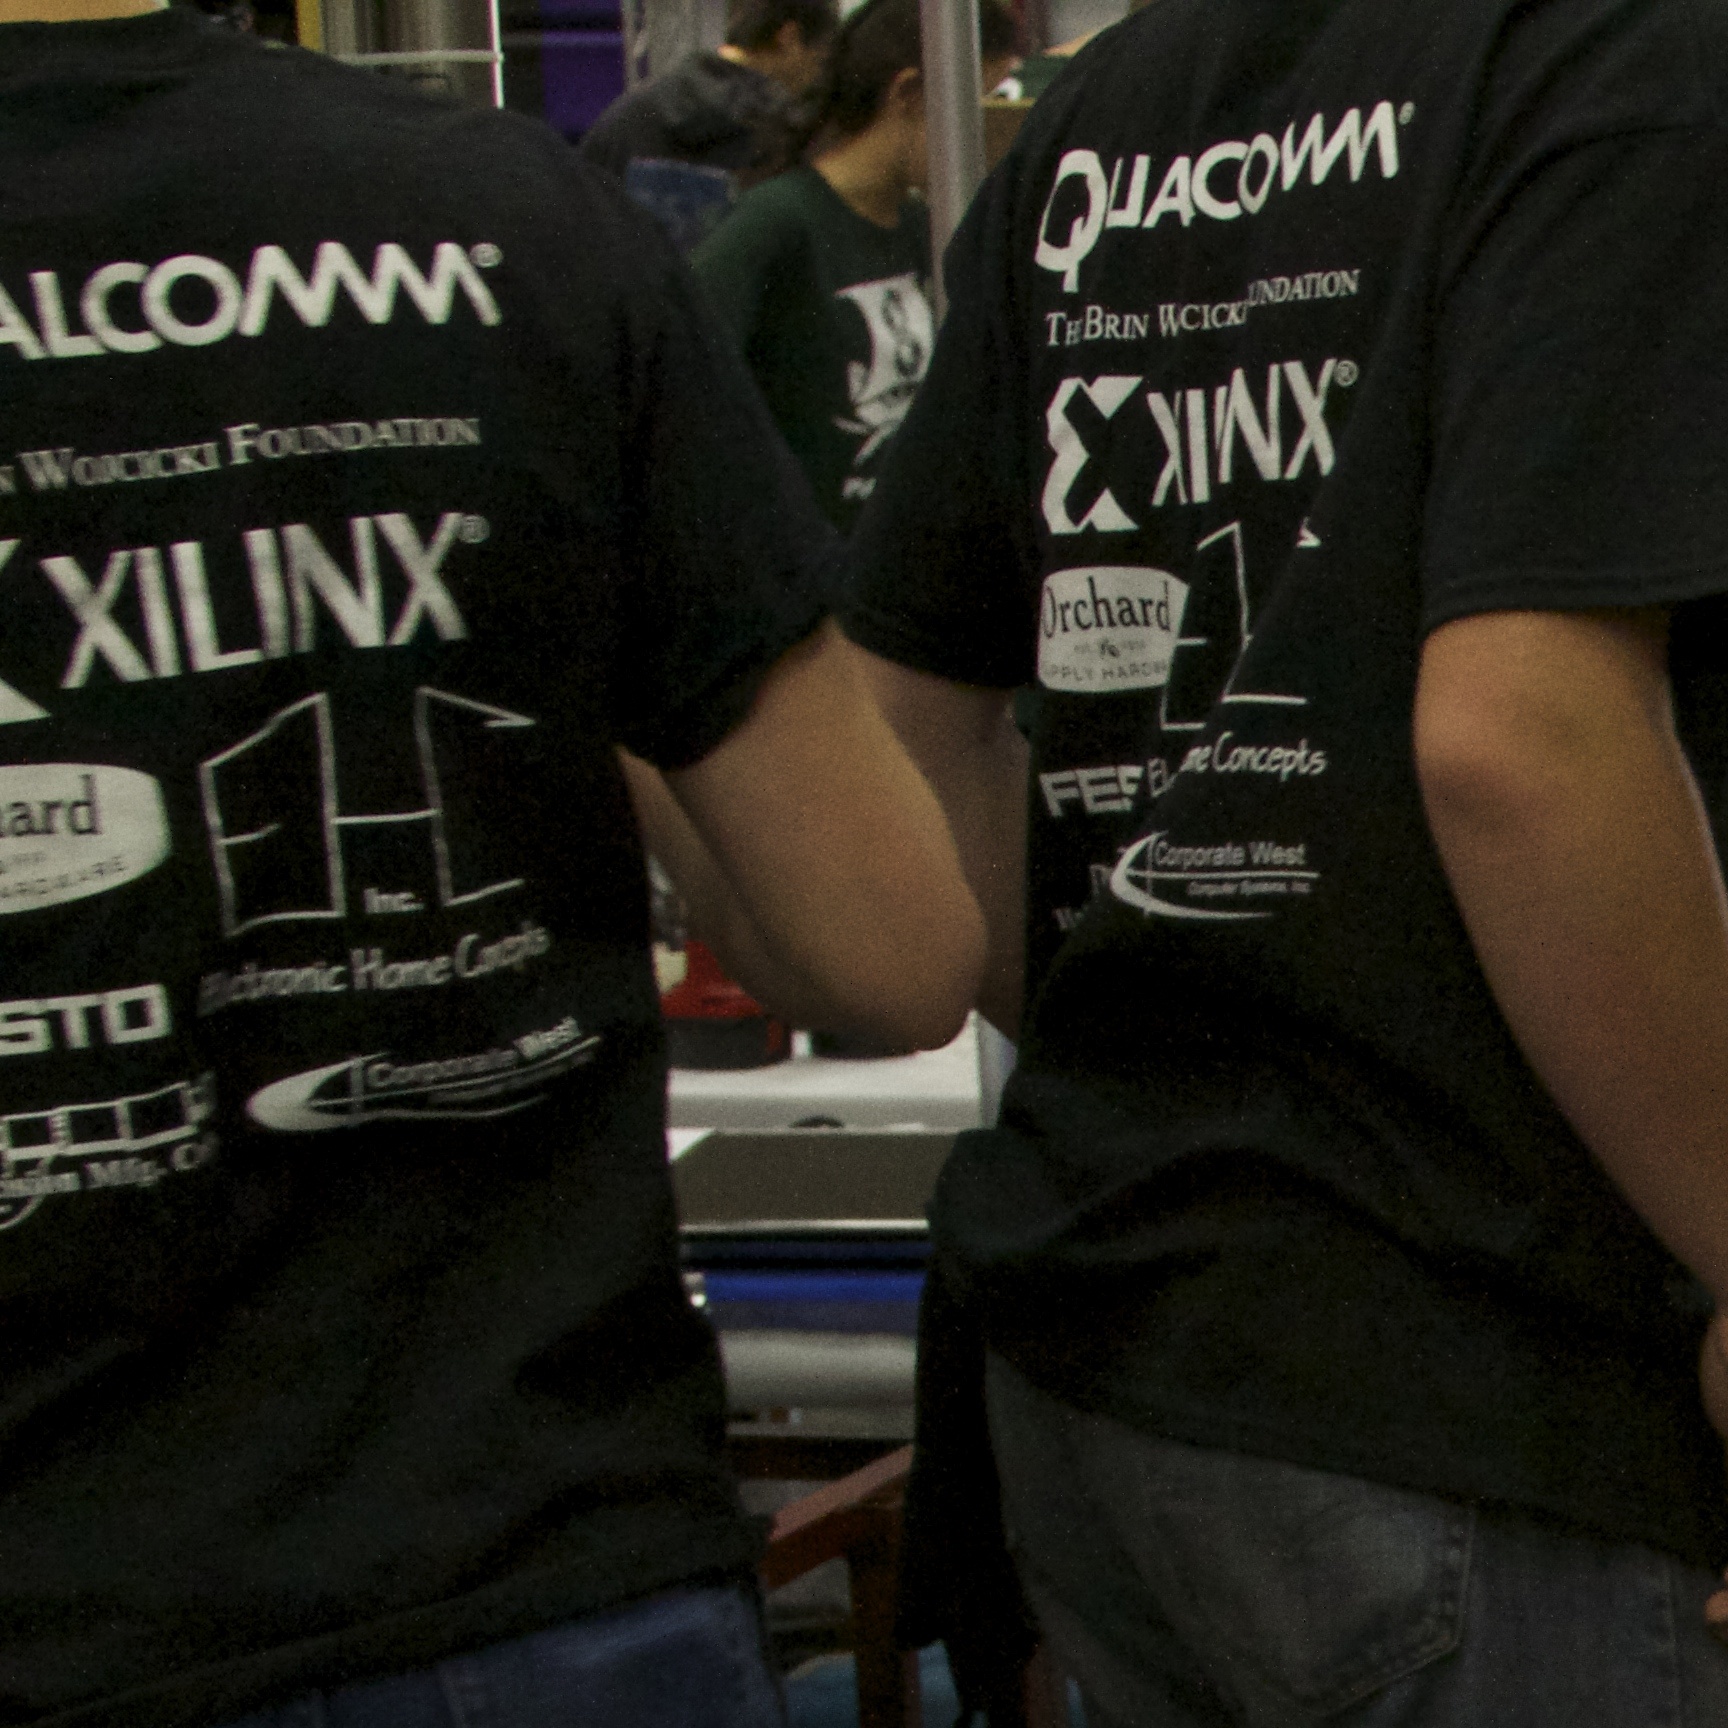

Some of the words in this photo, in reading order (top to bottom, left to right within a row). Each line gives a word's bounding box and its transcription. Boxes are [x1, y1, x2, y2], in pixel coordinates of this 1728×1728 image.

[223, 418, 480, 466] FOUNDATION
[40, 512, 468, 690] XILINX
[1041, 575, 1171, 639] Orchard
[1212, 731, 1328, 783] Concepts
[1154, 839, 1245, 870] Corporate
[1249, 840, 1307, 866] West
